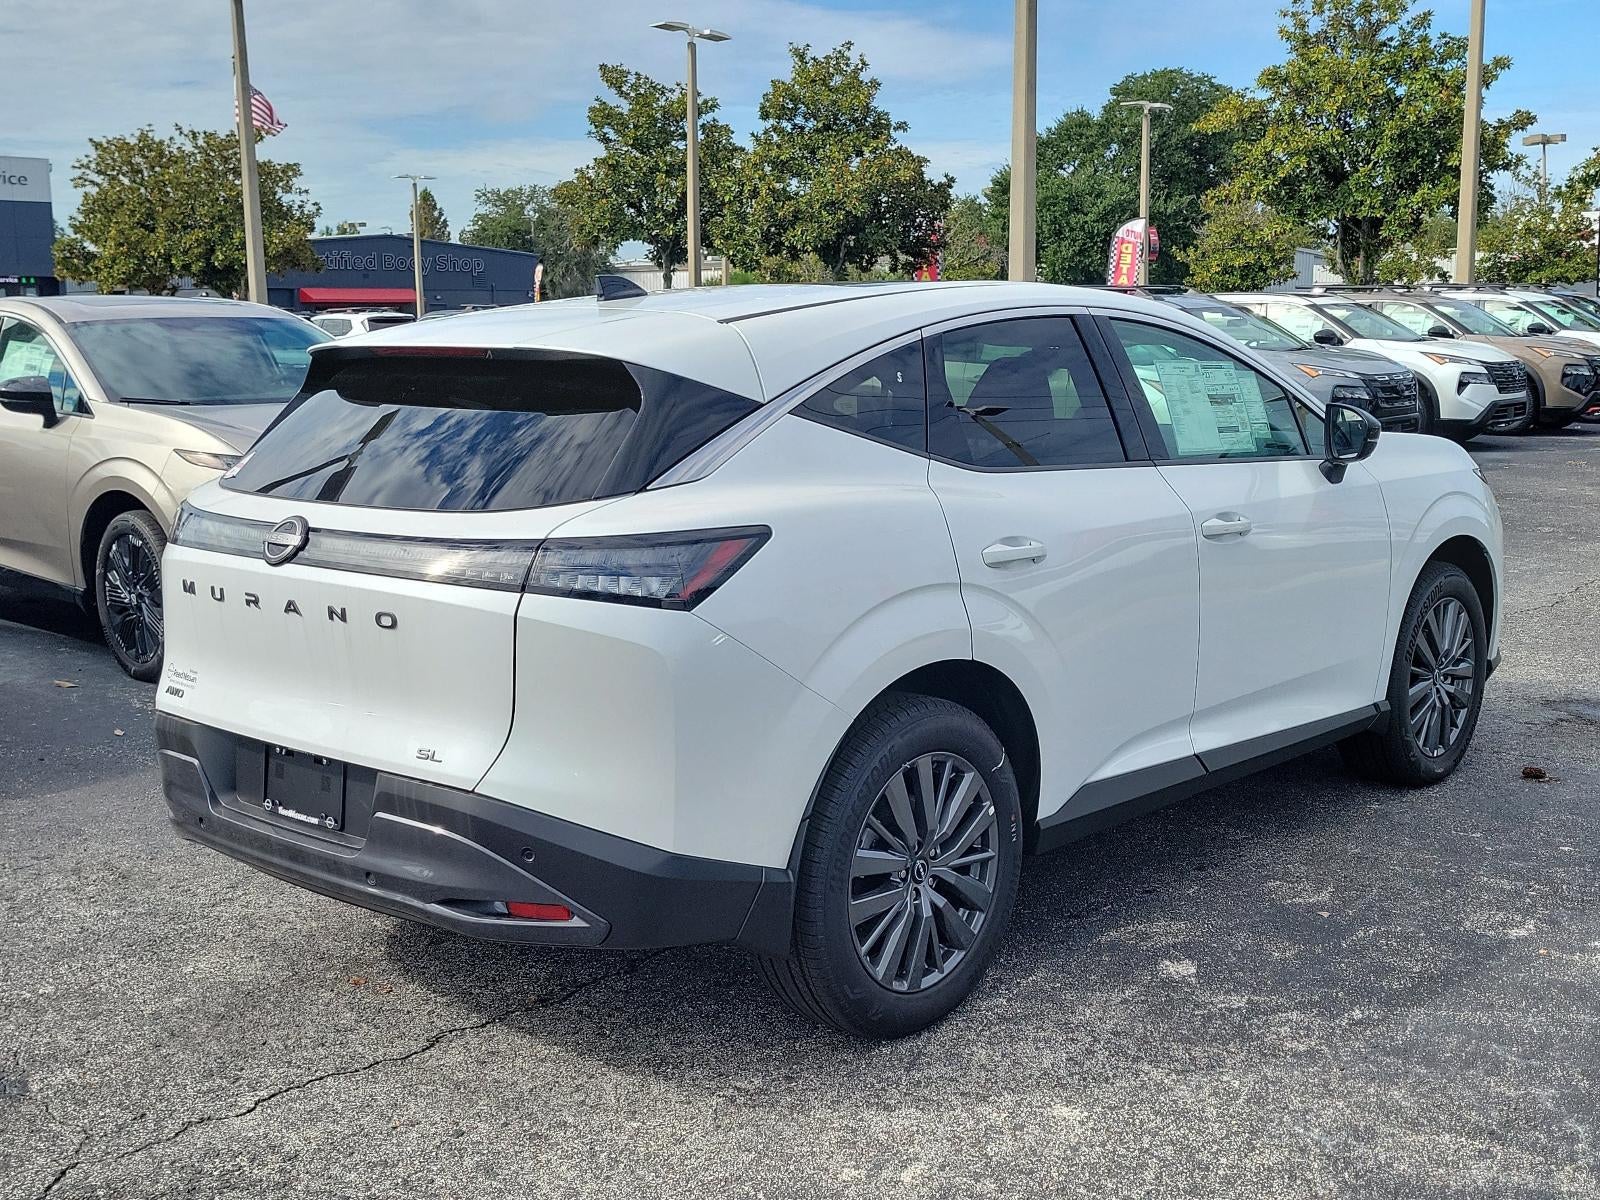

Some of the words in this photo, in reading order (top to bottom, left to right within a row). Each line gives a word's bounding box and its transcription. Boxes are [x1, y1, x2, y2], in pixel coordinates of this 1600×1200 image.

[0, 170, 28, 186] ice
[435, 253, 485, 277] Shop
[181, 578, 399, 630] MURANO
[165, 685, 185, 699] AWD
[415, 747, 443, 763] SL
